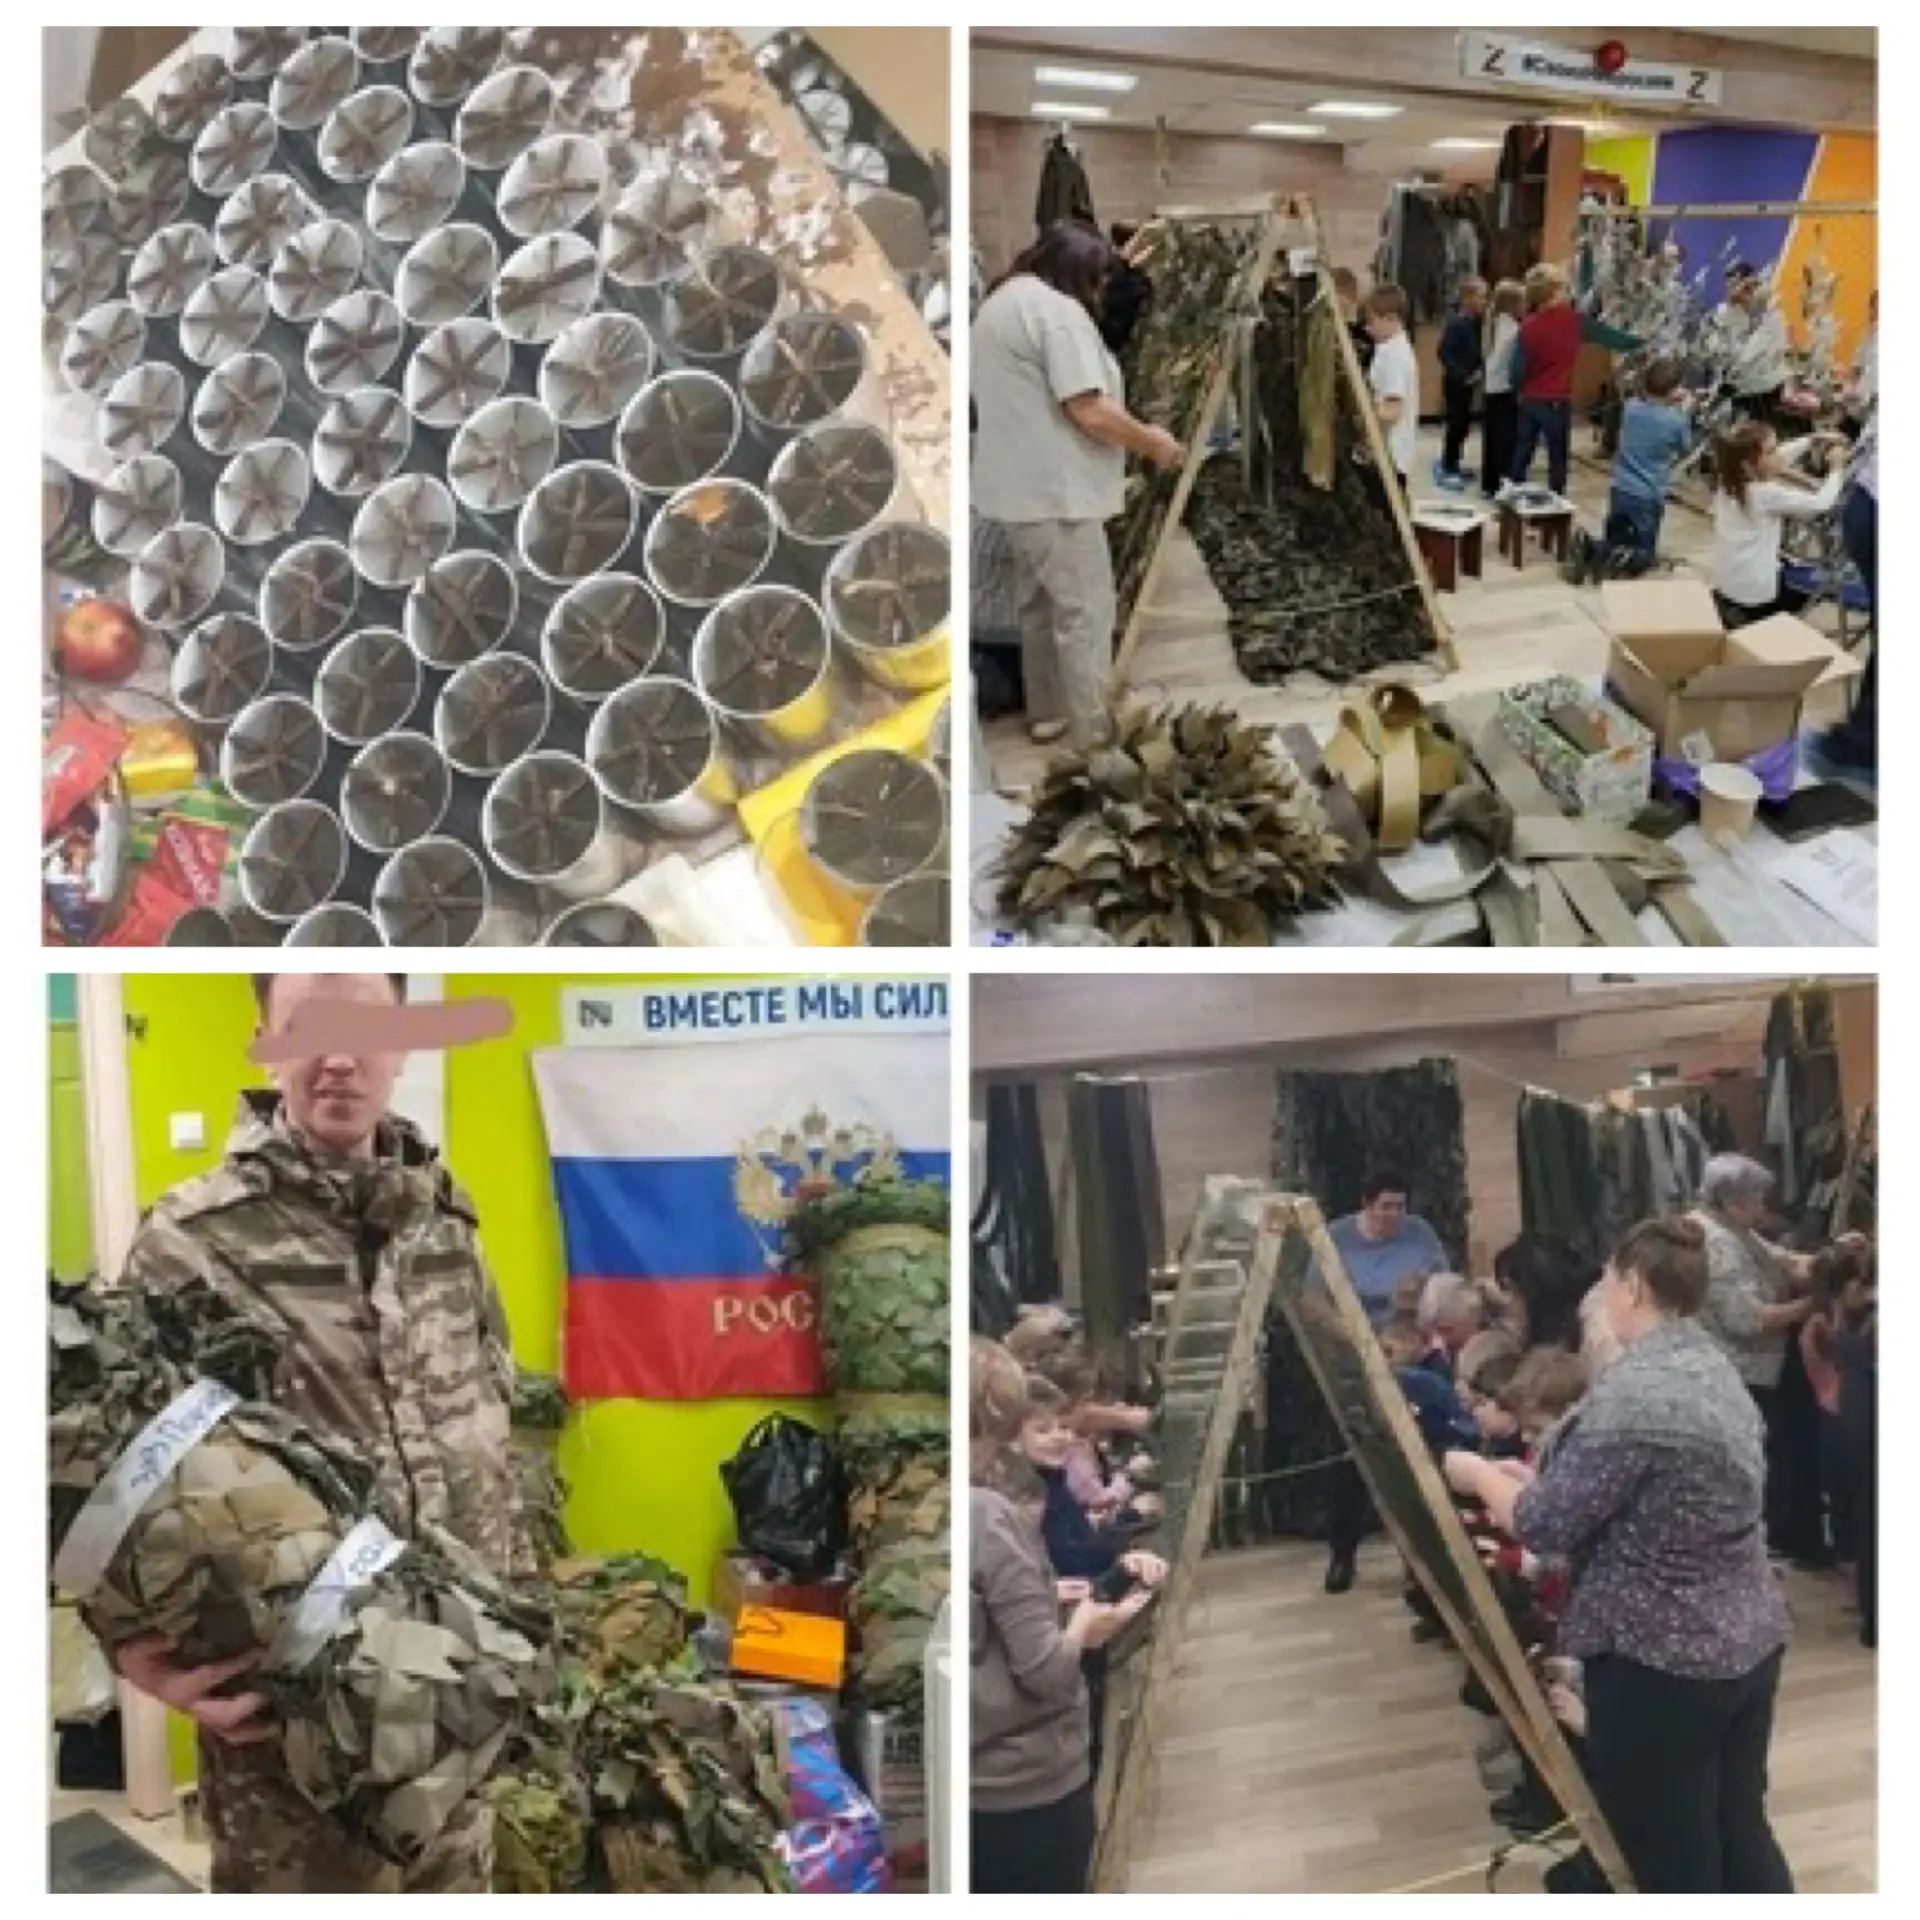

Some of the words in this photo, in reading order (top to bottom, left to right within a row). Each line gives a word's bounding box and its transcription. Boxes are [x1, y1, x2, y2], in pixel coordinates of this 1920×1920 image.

[1687, 70, 1709, 99] Z
[642, 987, 786, 1030] ВМЕСТЕ
[795, 983, 862, 1020] МЫ
[874, 982, 948, 1020] СИЛ
